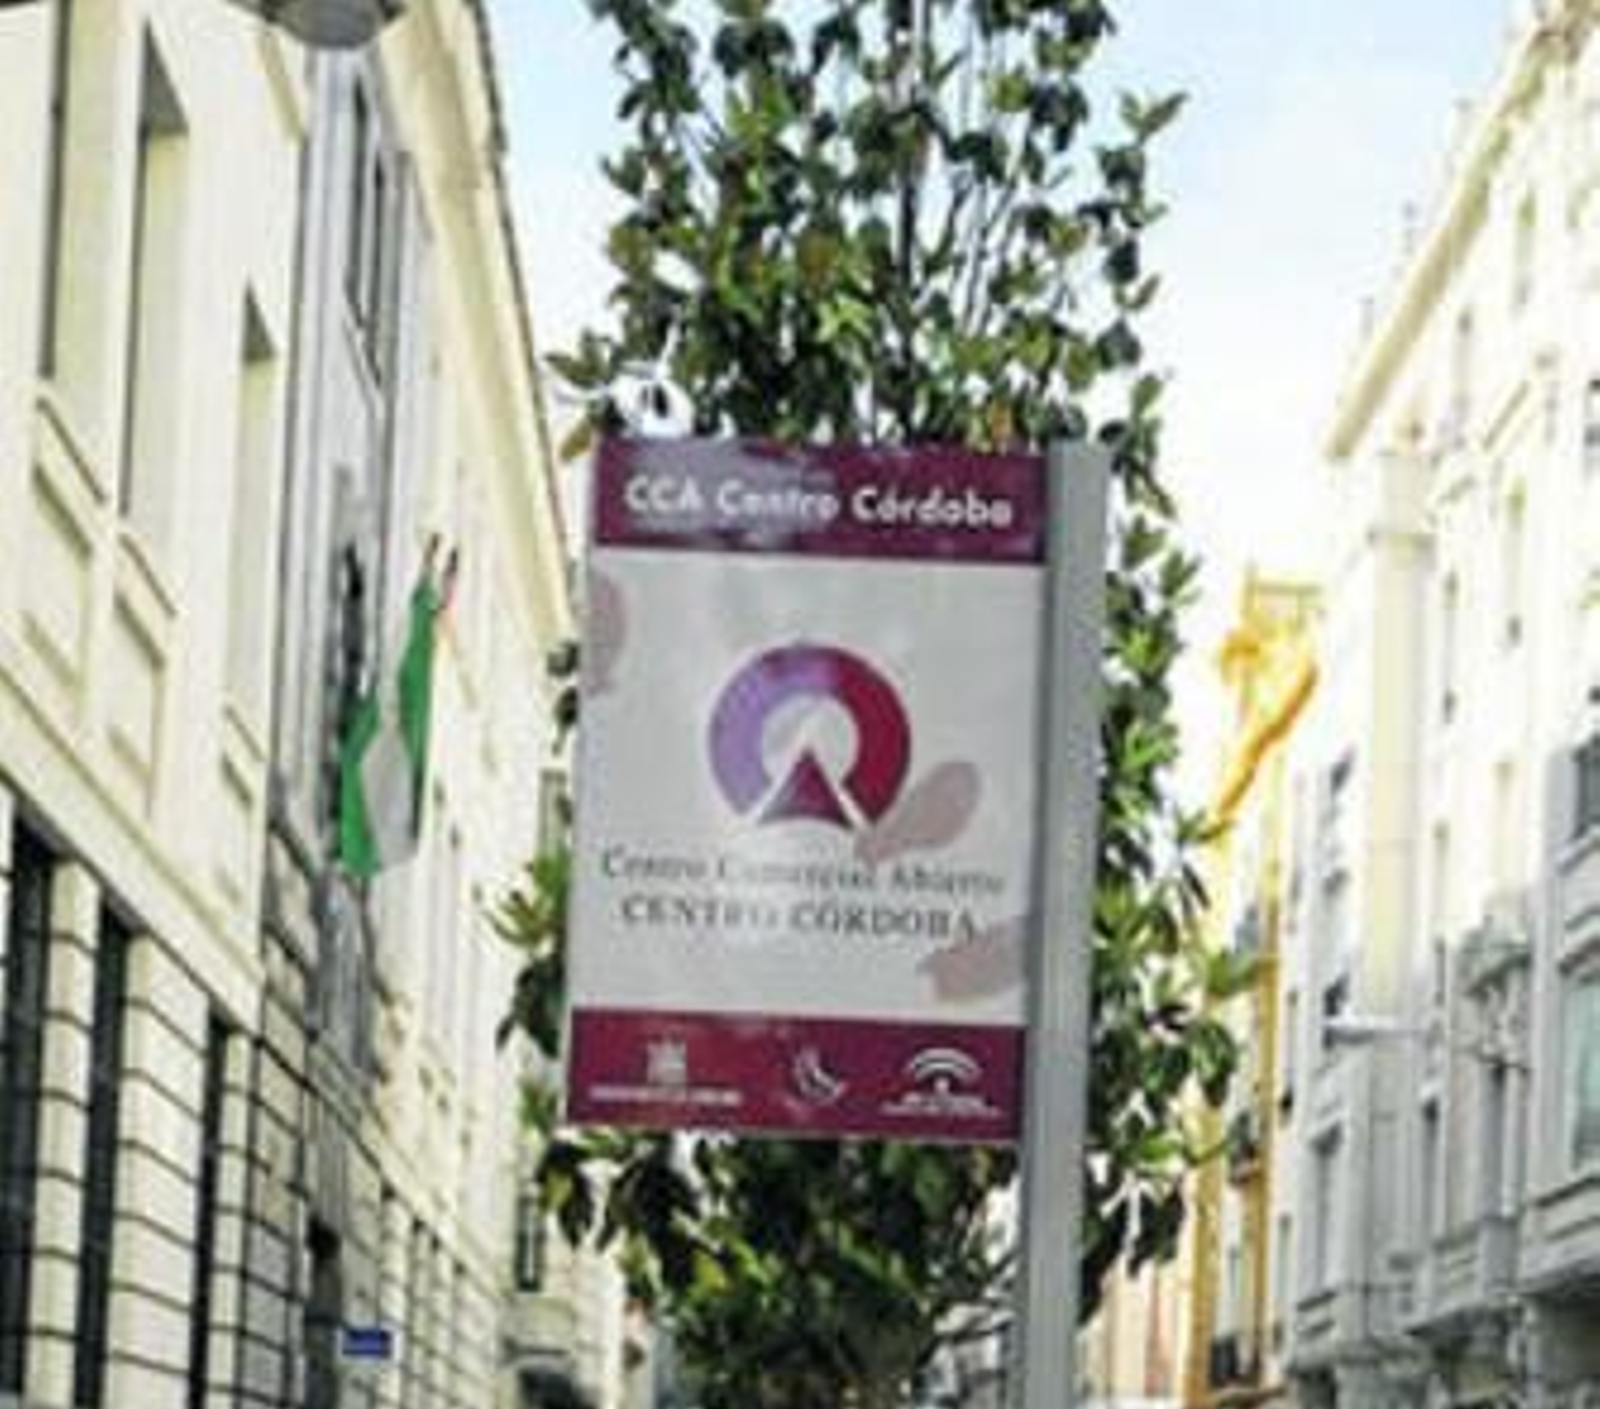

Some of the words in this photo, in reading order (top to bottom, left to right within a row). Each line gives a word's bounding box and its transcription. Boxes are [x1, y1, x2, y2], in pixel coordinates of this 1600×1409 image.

[624, 474, 700, 513] CCA
[851, 485, 1015, 528] Córdoba
[621, 897, 779, 930] CENTRO
[791, 899, 979, 940] CÓRDOBA
